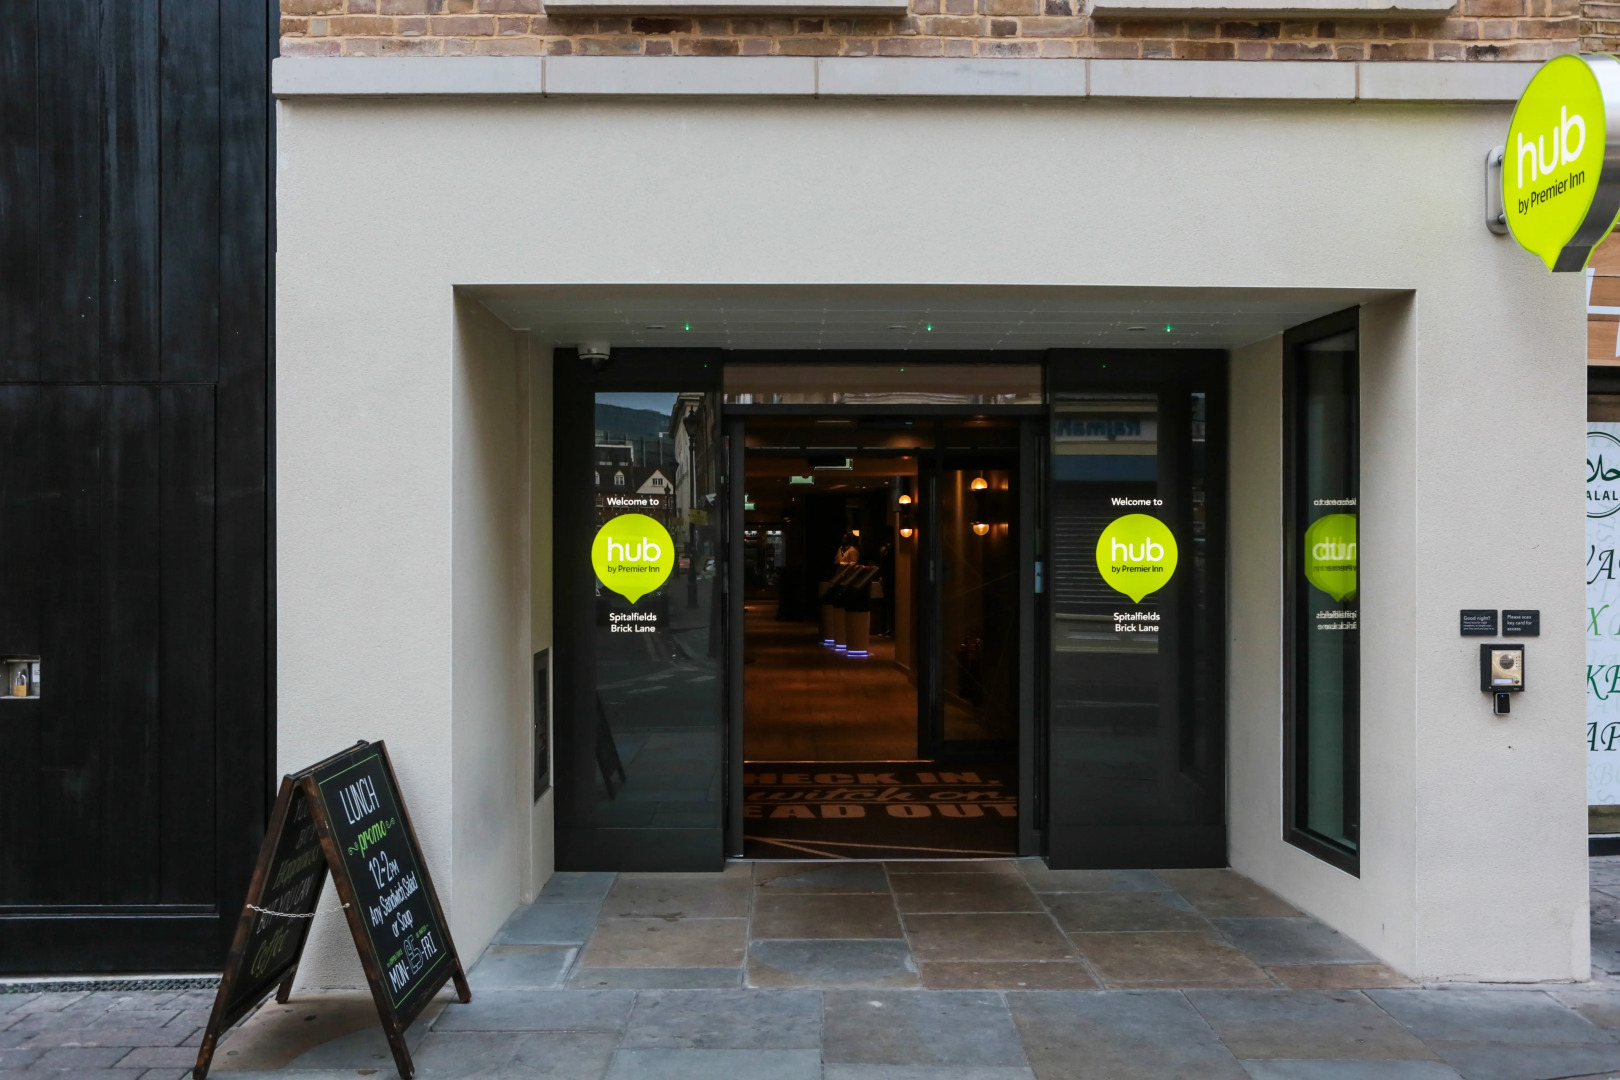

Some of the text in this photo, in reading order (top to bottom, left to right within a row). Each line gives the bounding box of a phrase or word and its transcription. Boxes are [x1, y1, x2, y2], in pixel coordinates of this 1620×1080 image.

[1517, 105, 1586, 189] hub
[1518, 170, 1585, 215] by Premier Inn
[607, 497, 660, 506] Welcome to
[1111, 497, 1163, 506] Welcome to
[607, 536, 662, 562] hub
[1111, 537, 1165, 562] hub
[608, 565, 660, 574] by Premier Inn
[1111, 565, 1164, 574] by Premier Inn
[609, 612, 657, 623] Spitalfields
[1113, 612, 1161, 623] Spitalfields
[611, 624, 656, 633] Brick Lane
[1115, 624, 1159, 633] Brick Lane
[743, 772, 902, 784] HECK
[339, 774, 380, 825] LUNCH
[357, 820, 387, 859] promo
[369, 905, 384, 928] Any
[391, 922, 399, 938] or
[396, 909, 414, 932] Soup
